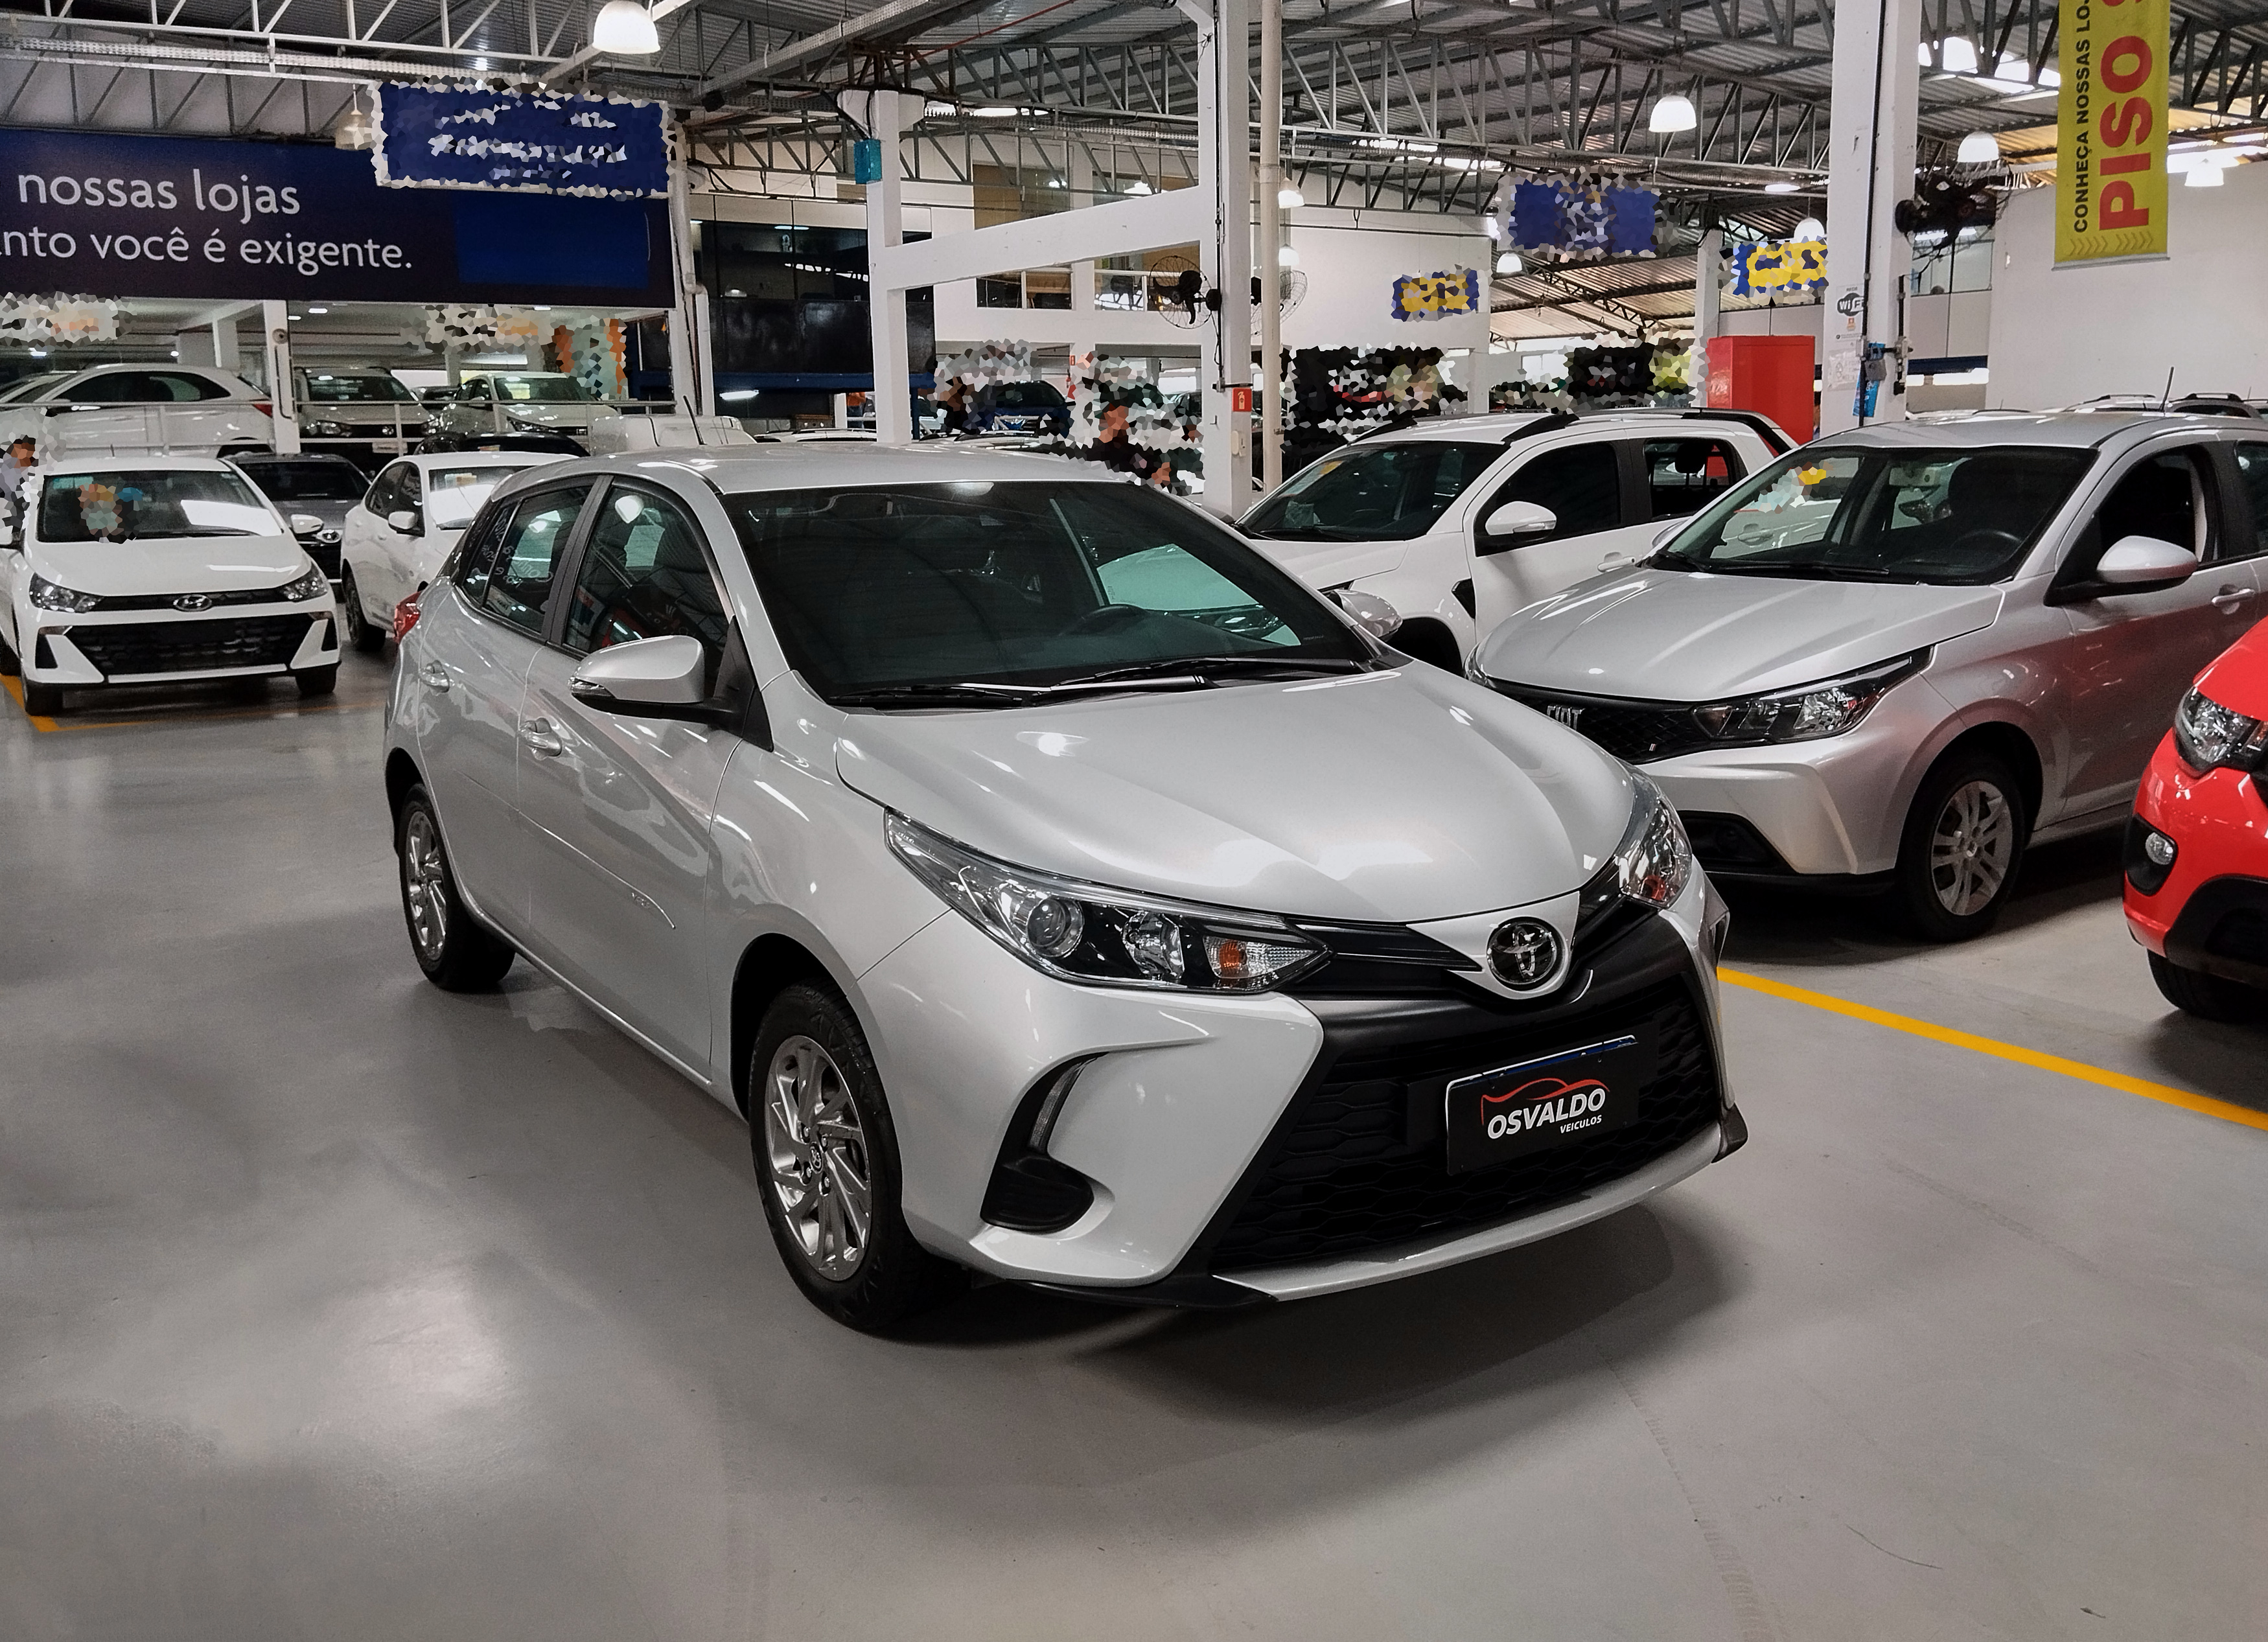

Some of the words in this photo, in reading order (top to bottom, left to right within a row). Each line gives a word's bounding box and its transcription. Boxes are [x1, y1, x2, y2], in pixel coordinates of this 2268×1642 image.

[2076, 0, 2090, 32] LO
[2075, 39, 2090, 124] NOSSAS
[2099, 36, 2153, 231] PISO
[18, 174, 178, 209] nossas
[193, 168, 300, 224] lojas
[2074, 130, 2092, 233] CONHEÇA
[0, 226, 76, 257] nto
[90, 226, 189, 262] você
[203, 228, 226, 263] é
[240, 233, 412, 276] exigente.
[1487, 1088, 1606, 1139] OSVALDO
[1560, 1115, 1603, 1134] VEICULOS
